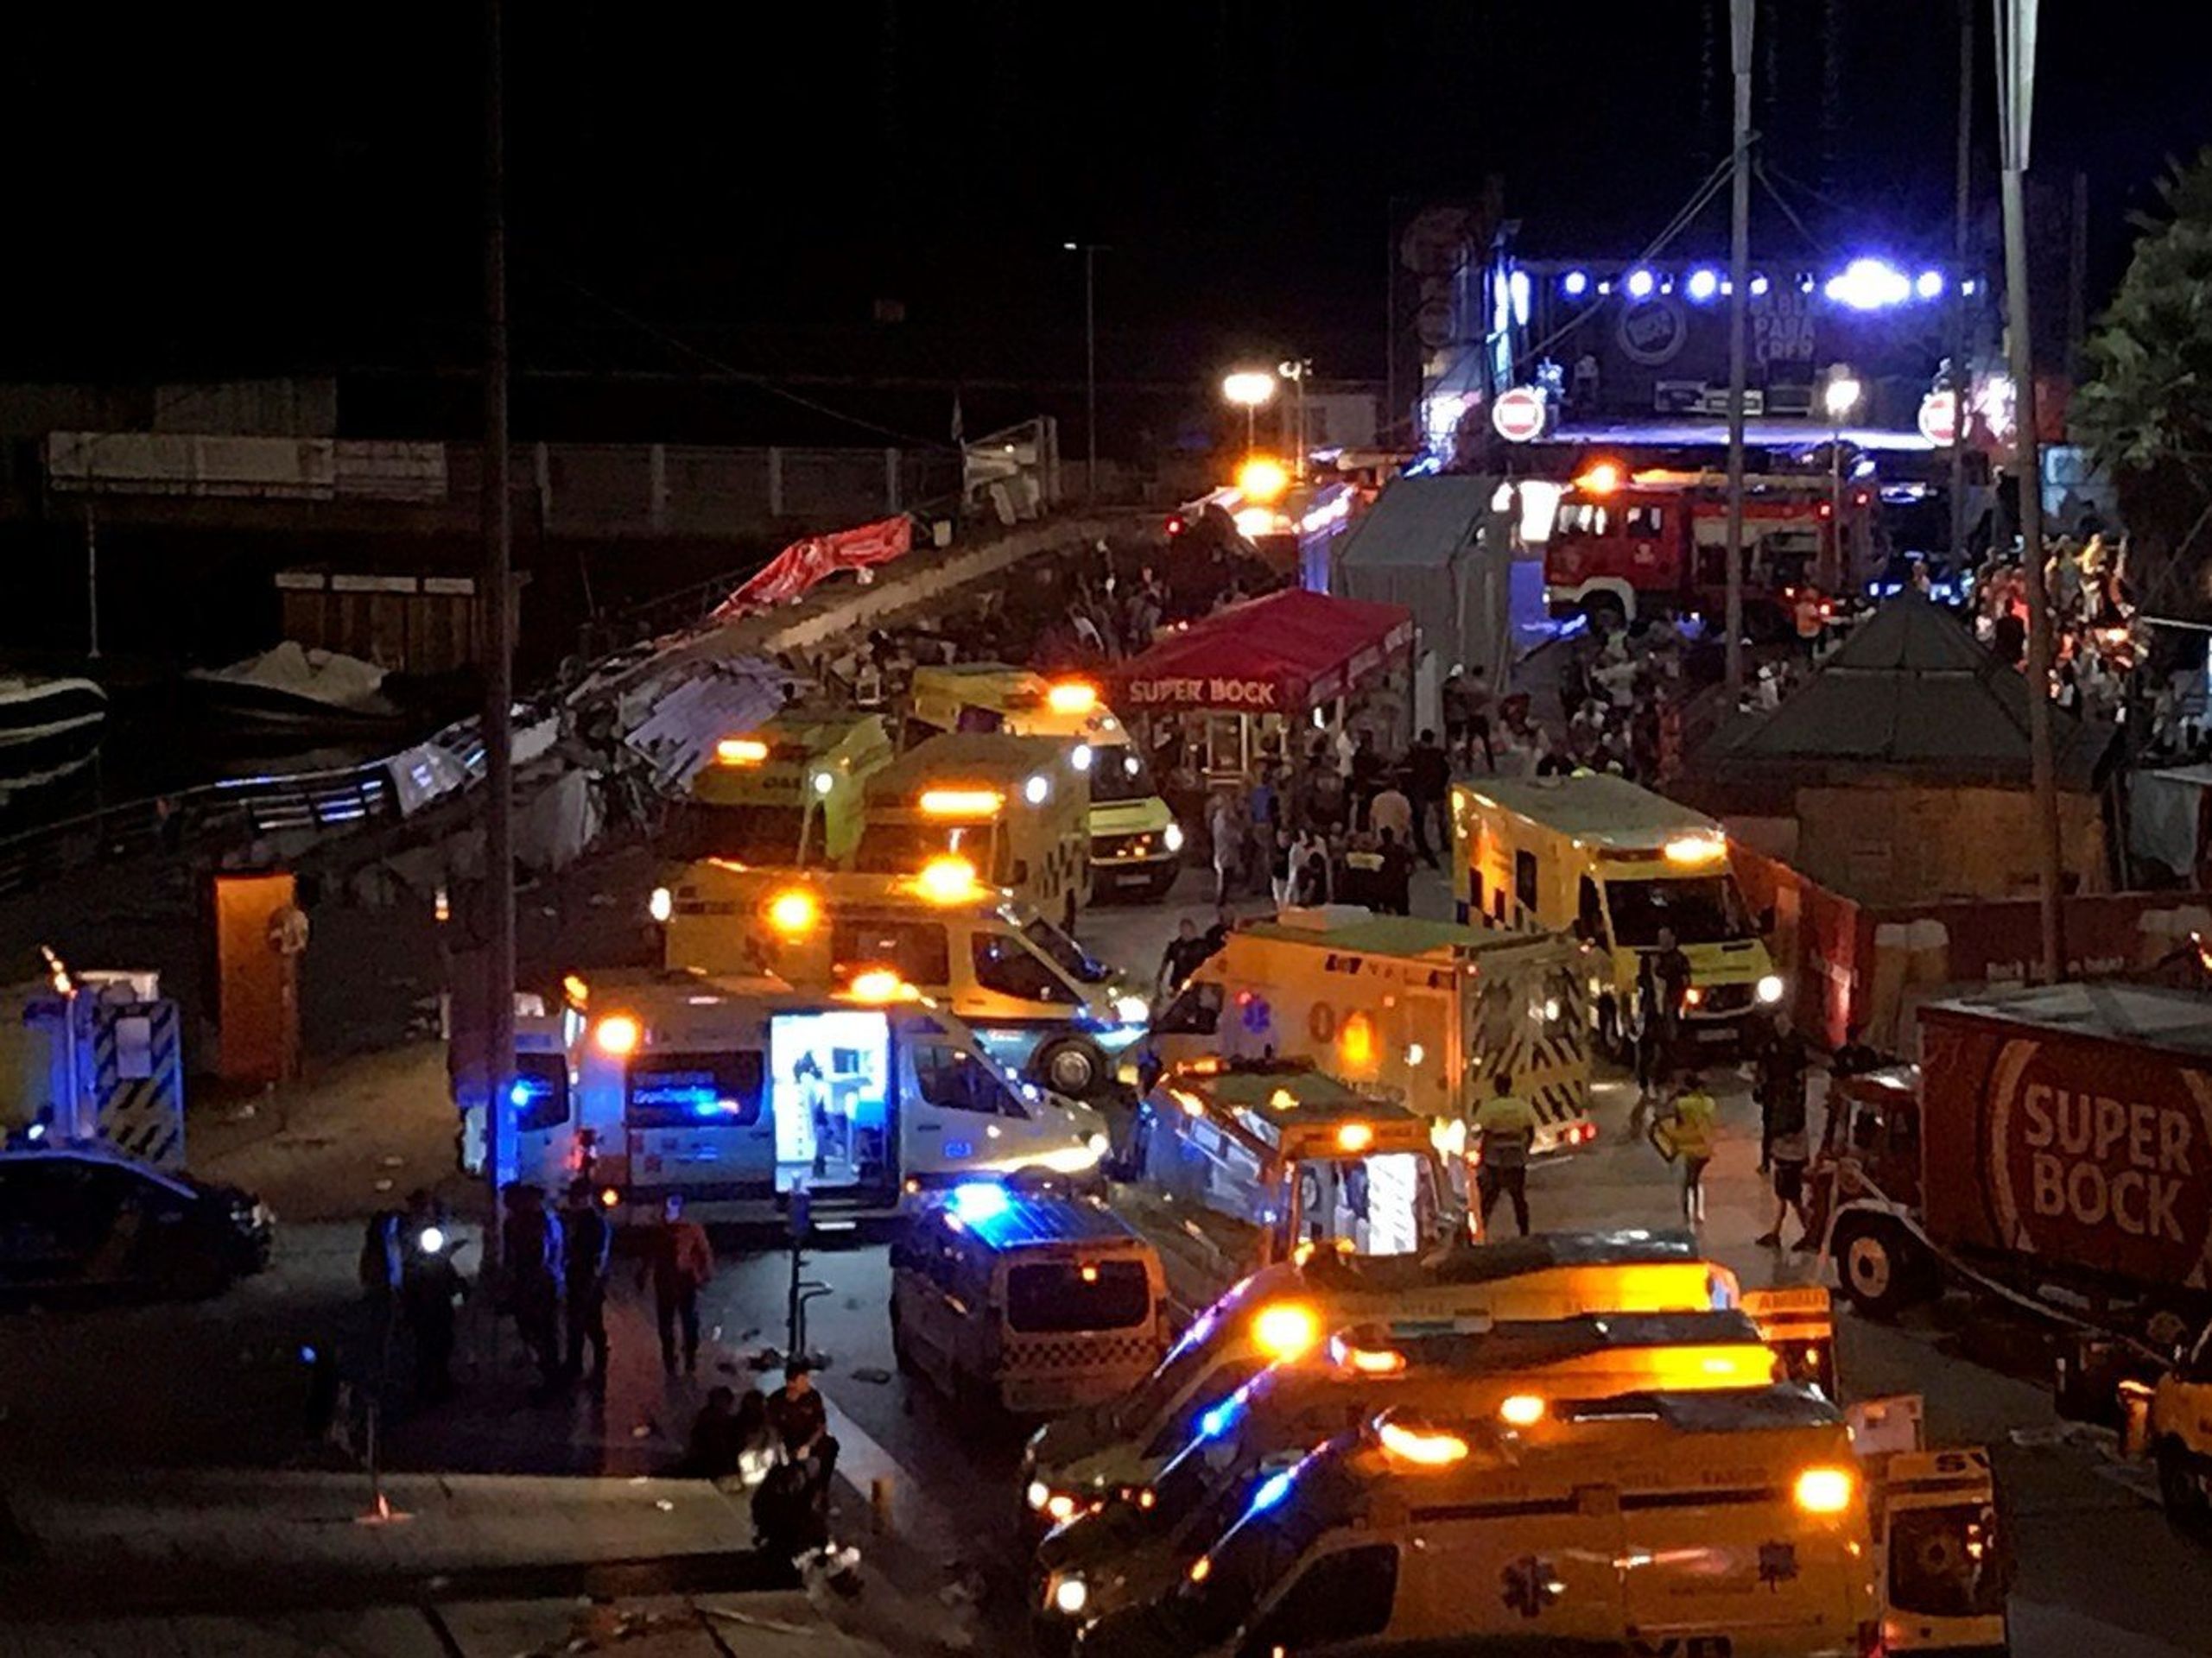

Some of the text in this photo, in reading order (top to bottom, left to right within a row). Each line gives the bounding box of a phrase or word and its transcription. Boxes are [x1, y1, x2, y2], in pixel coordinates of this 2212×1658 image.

[1129, 677, 1275, 705] SUPER BOCK
[2024, 1082, 2194, 1176] SUPER
[2032, 1149, 2186, 1244] BOCK
